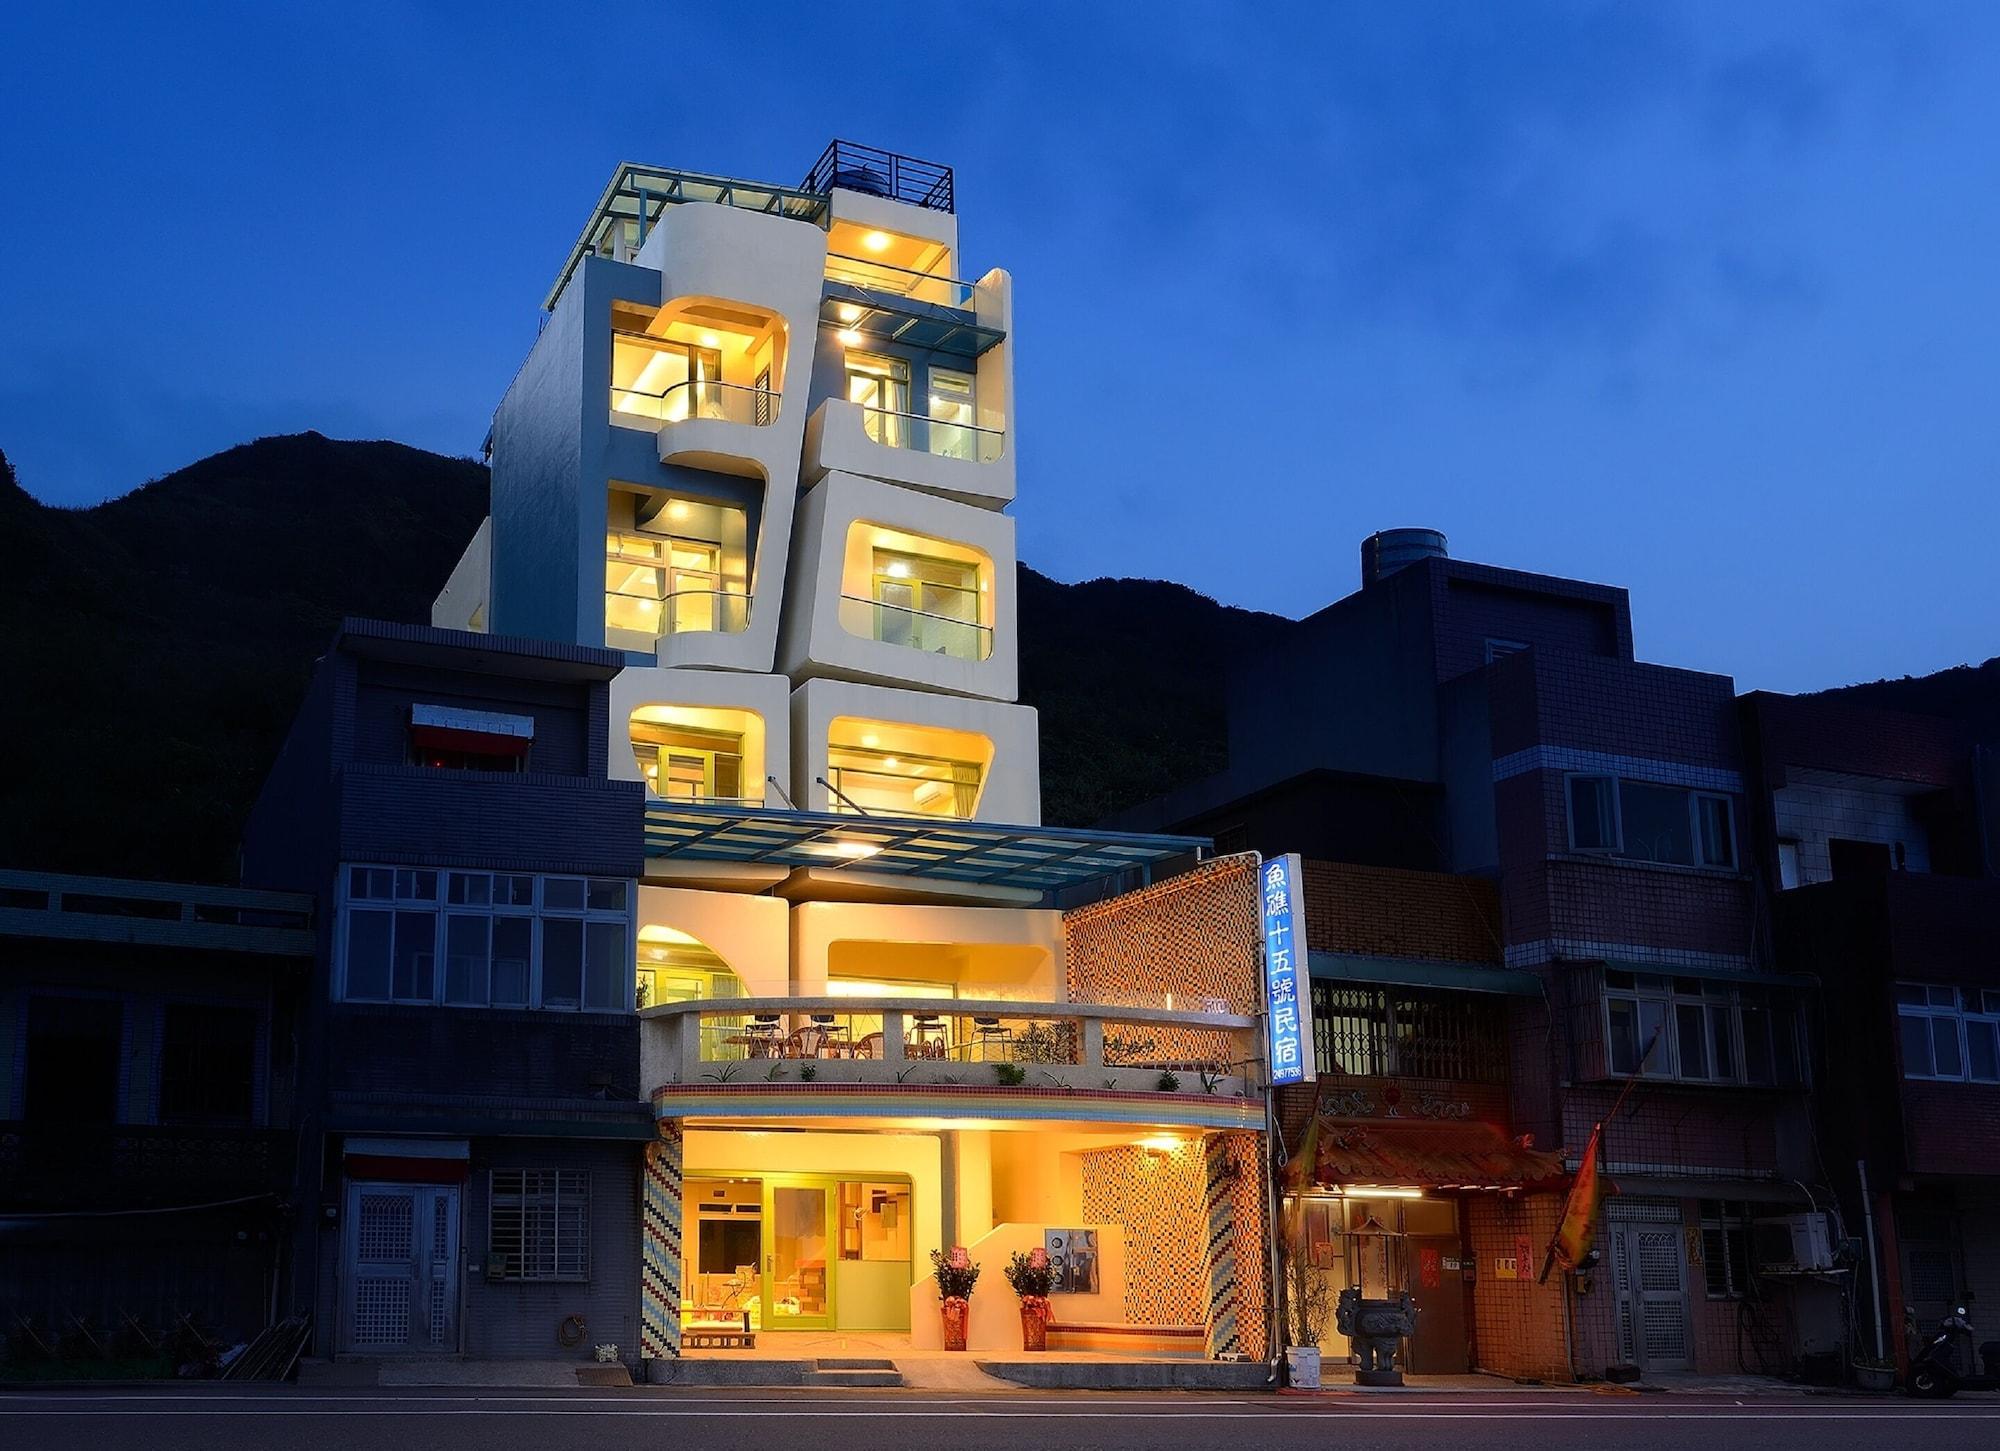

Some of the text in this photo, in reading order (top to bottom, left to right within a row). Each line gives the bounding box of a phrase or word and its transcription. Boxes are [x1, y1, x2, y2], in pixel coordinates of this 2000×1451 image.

[1265, 863, 1297, 1063] 魚礁十五號民宿
